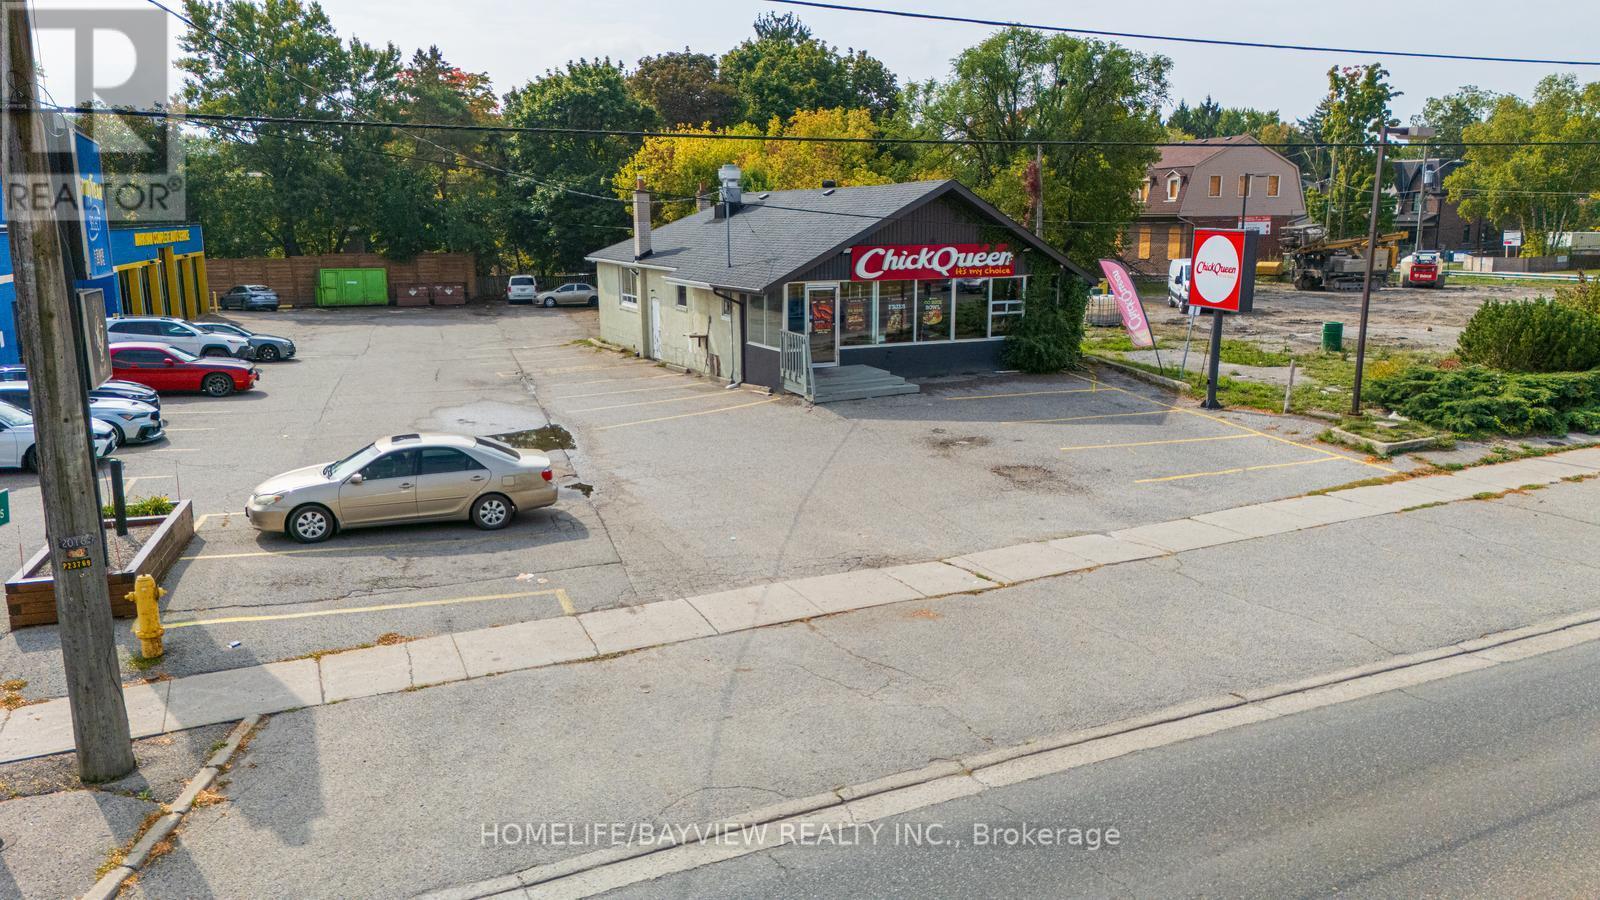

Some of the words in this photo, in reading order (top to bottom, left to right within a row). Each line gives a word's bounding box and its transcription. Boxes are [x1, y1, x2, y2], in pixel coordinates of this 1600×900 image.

[855, 246, 1014, 279] ChickQueen
[1196, 261, 1237, 276] ChickQueen
[969, 268, 983, 276] my
[984, 266, 1011, 275] choice
